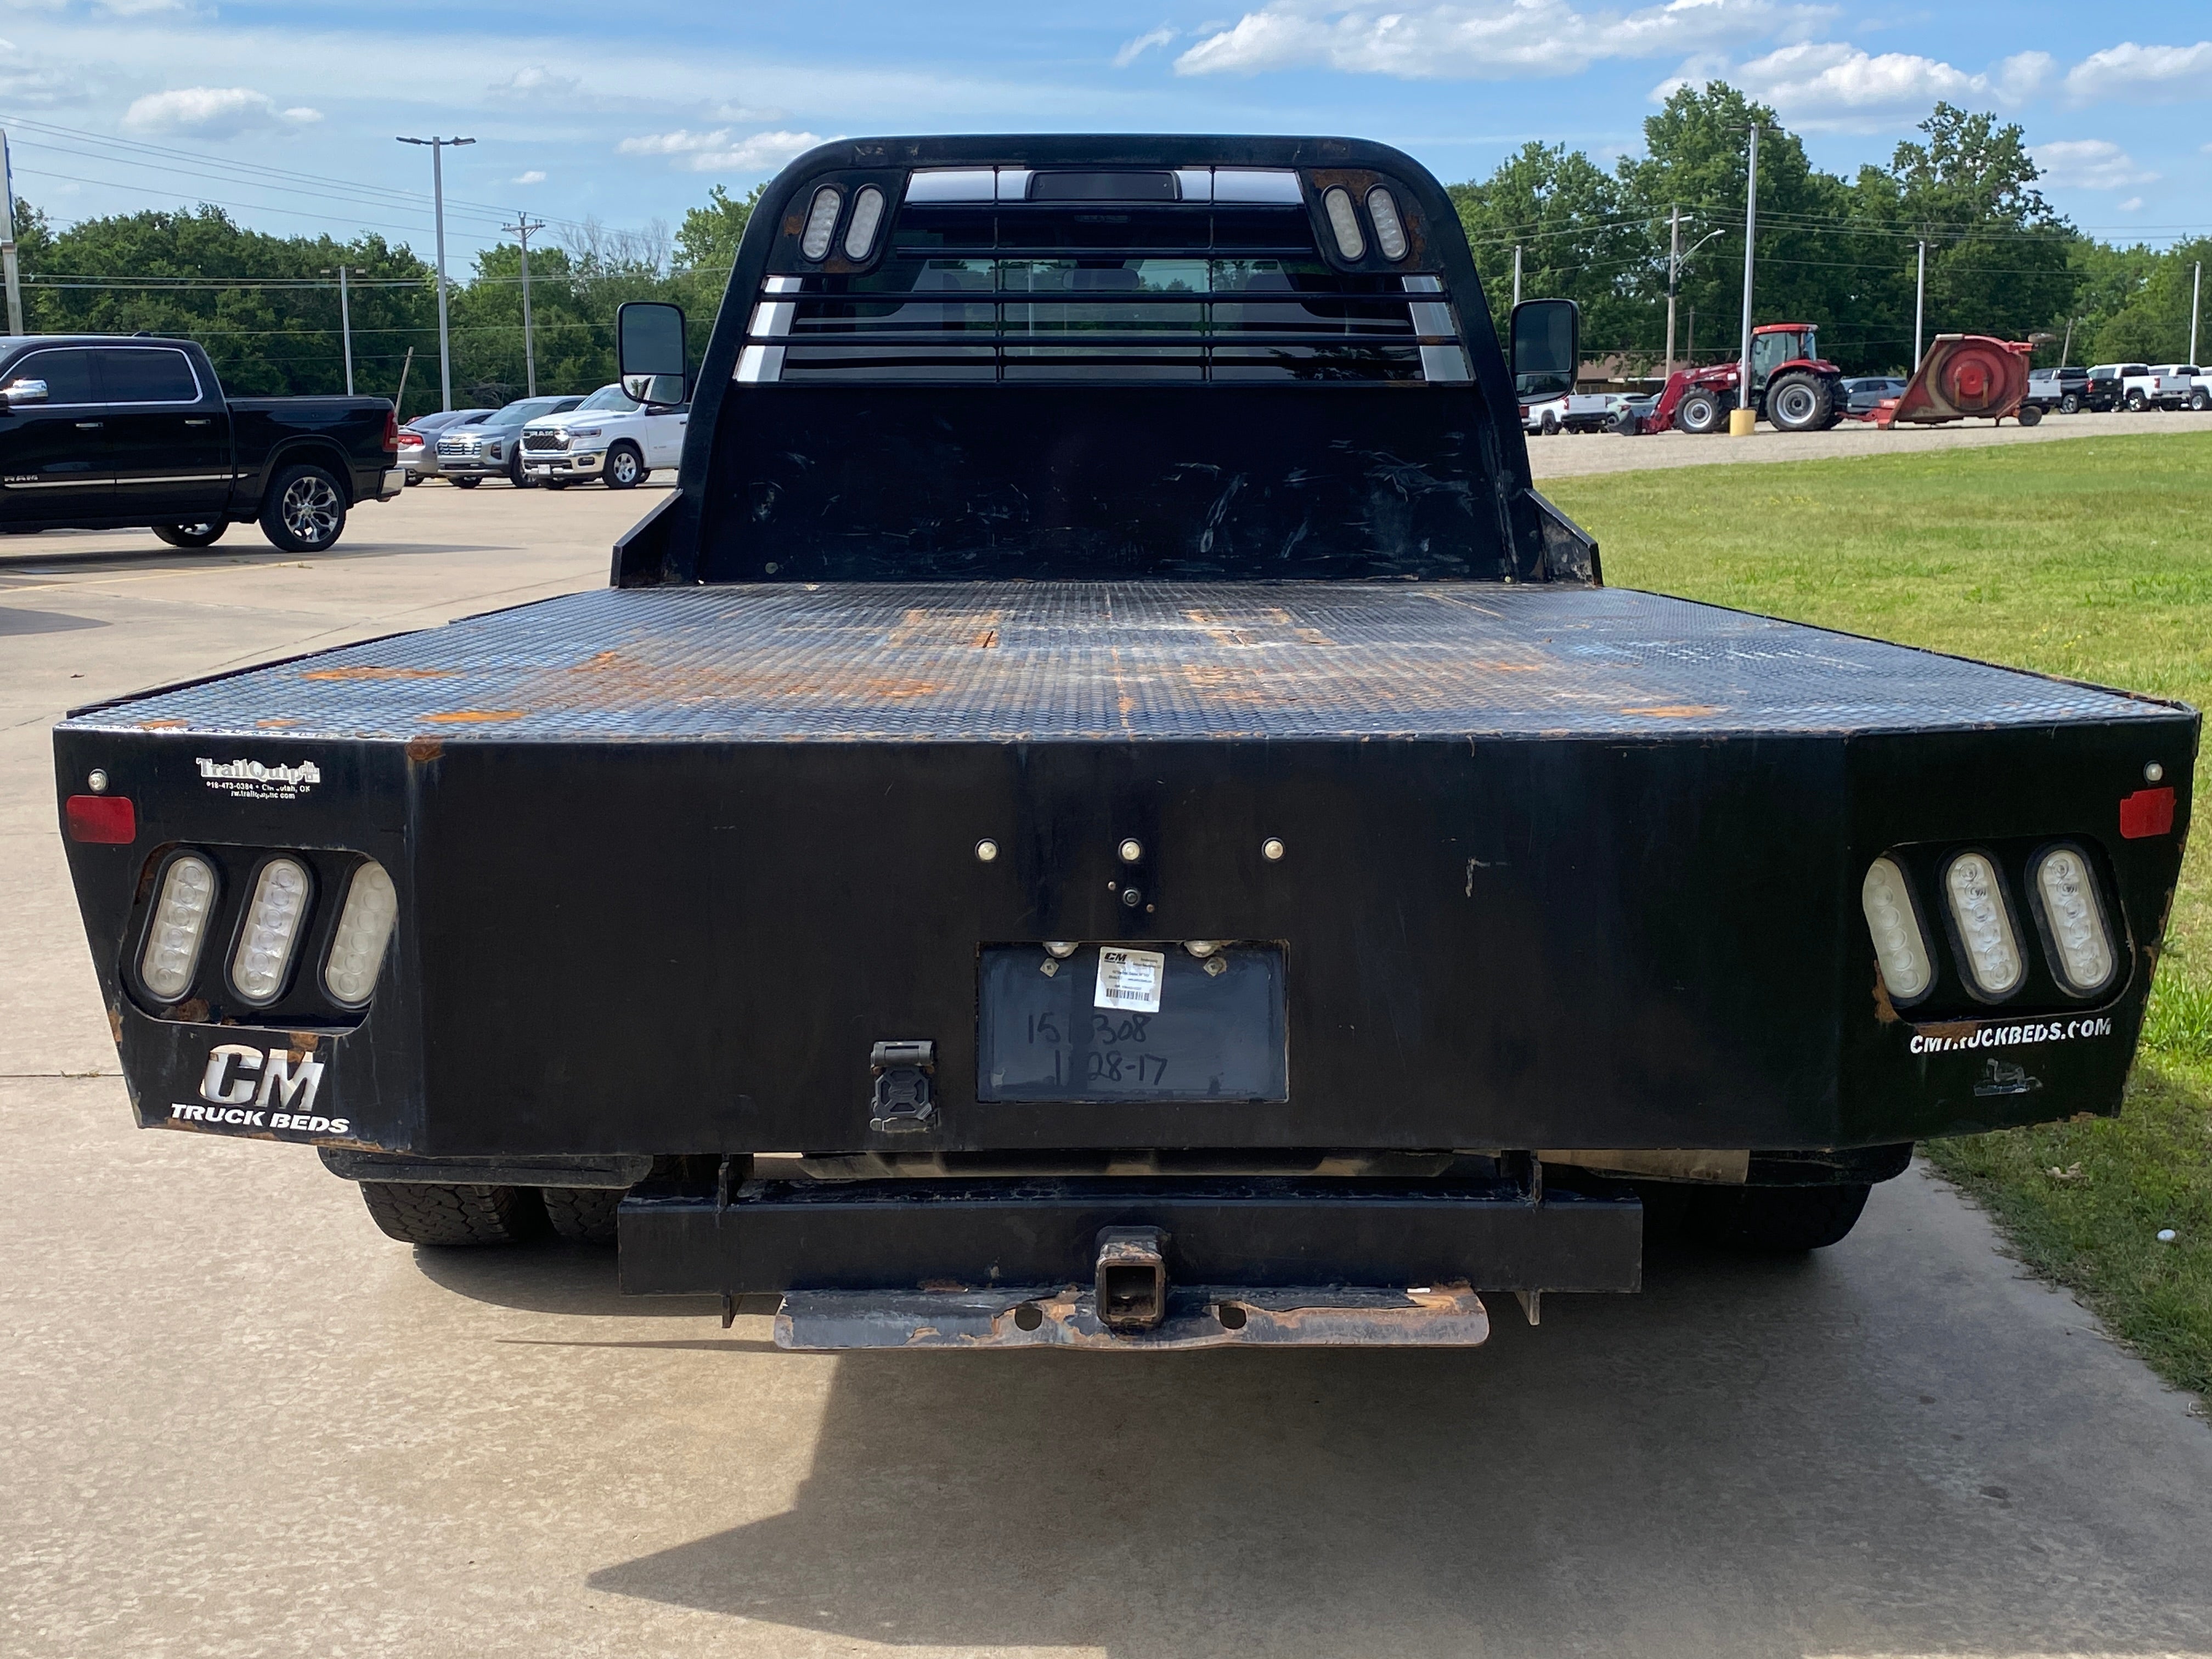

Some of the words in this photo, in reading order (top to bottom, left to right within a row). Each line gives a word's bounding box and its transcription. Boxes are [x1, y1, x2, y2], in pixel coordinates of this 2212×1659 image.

[196, 757, 303, 785] TrailQuip
[1104, 952, 1127, 962] CM
[199, 1043, 325, 1111] CM
[171, 1103, 265, 1126] TRUCK
[269, 1113, 350, 1133] BEDS
